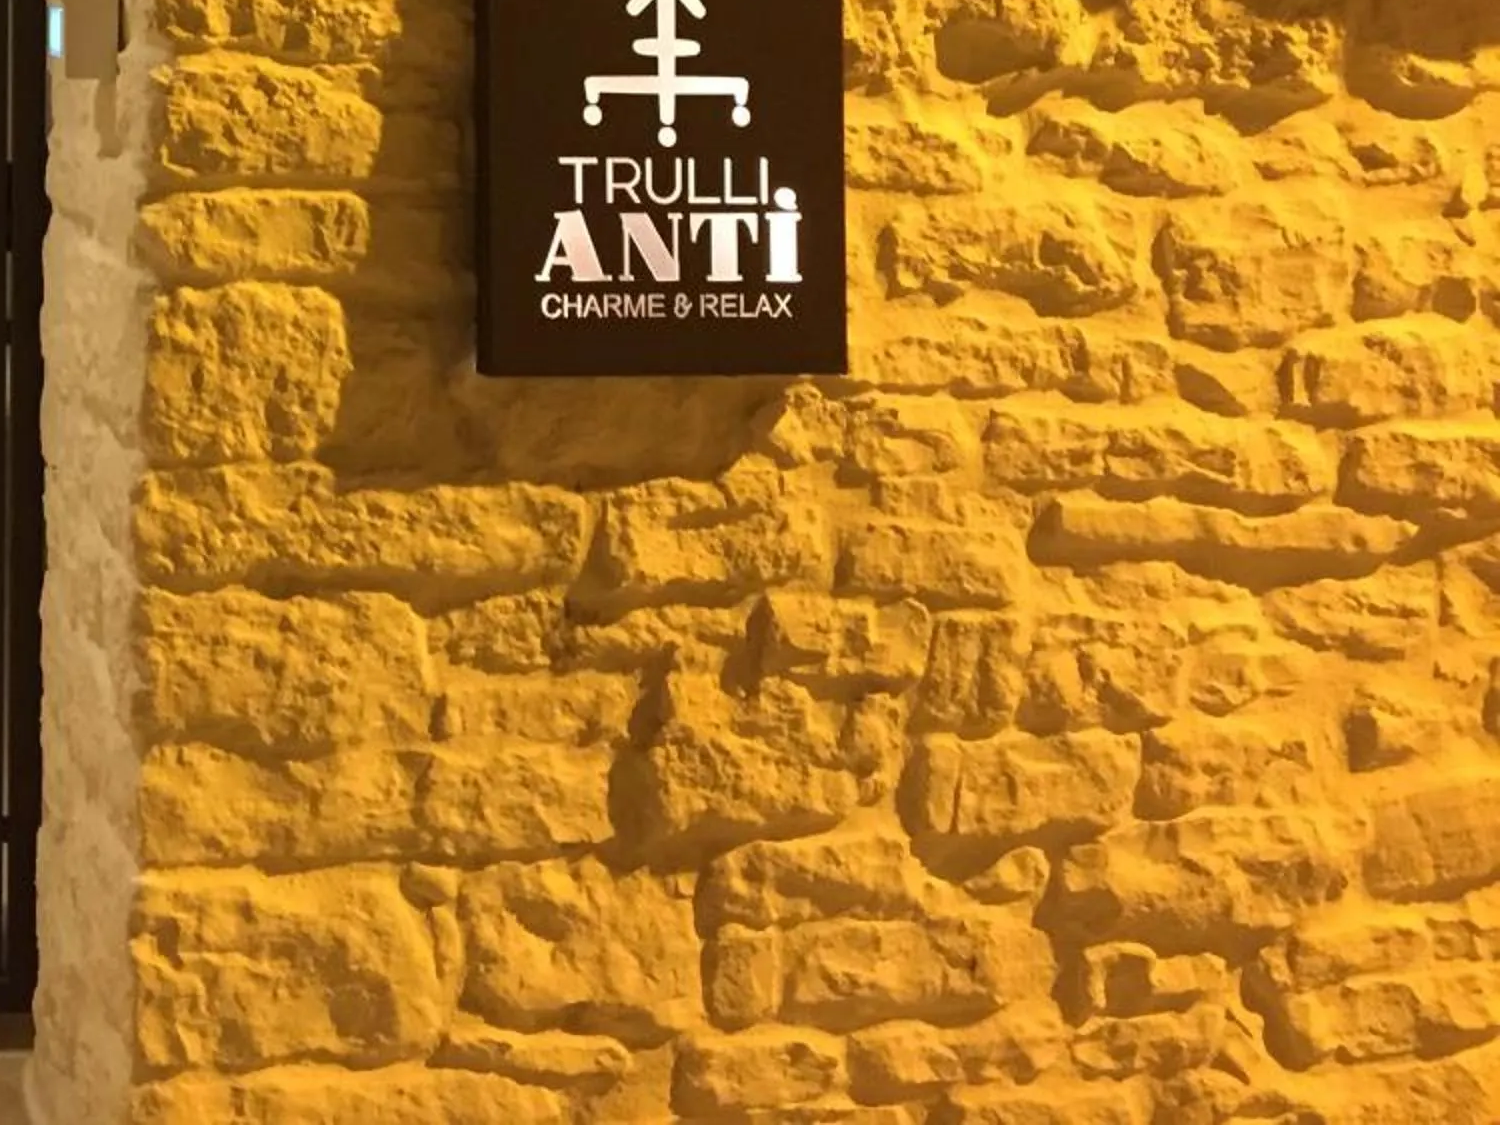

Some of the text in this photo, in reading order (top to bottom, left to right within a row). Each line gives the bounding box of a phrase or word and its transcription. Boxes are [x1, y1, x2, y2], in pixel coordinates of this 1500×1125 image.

[557, 156, 769, 205] TRULLI
[540, 292, 793, 320] CHARME & RELAX
